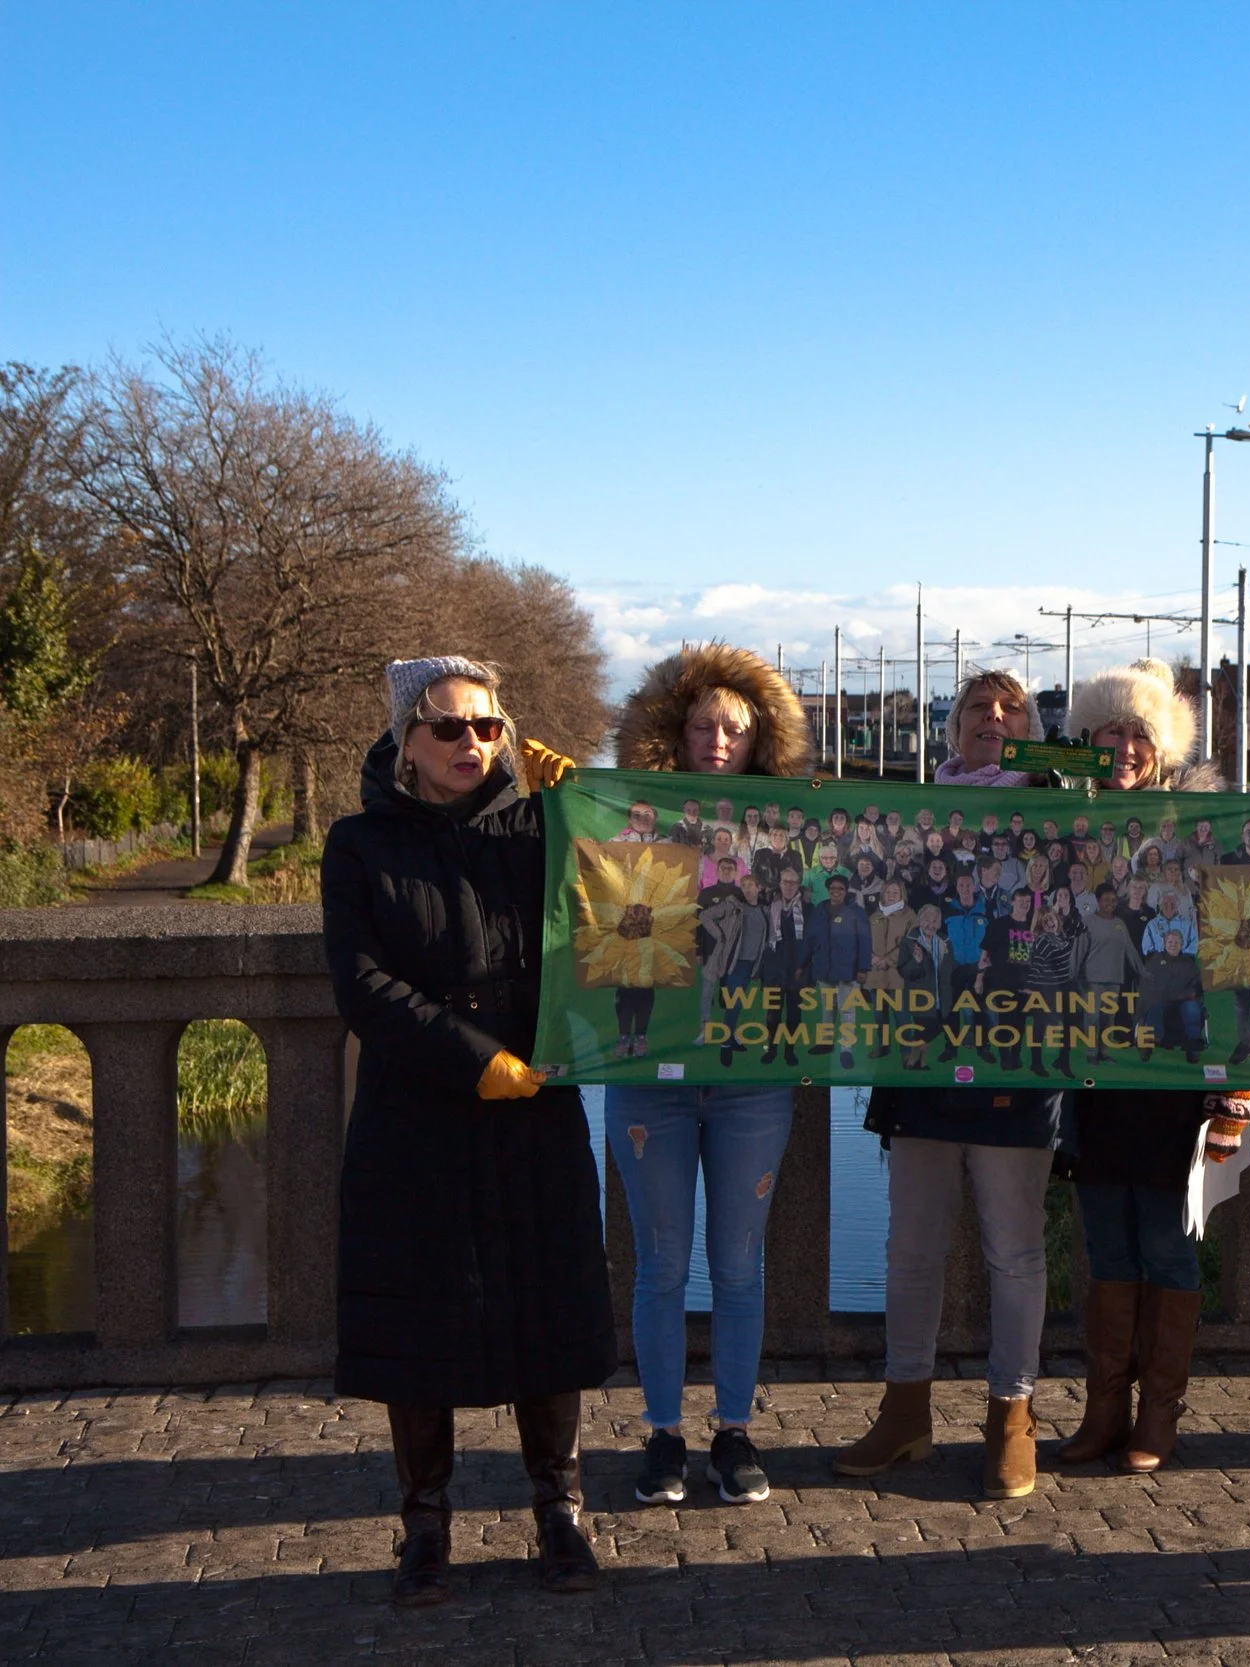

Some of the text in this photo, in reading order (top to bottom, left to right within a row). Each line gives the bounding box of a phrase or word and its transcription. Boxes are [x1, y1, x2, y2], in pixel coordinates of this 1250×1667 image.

[721, 986, 1140, 1014] WE STAND AGAINST
[704, 1022, 1155, 1049] DOMESTIC VIOLENCE
